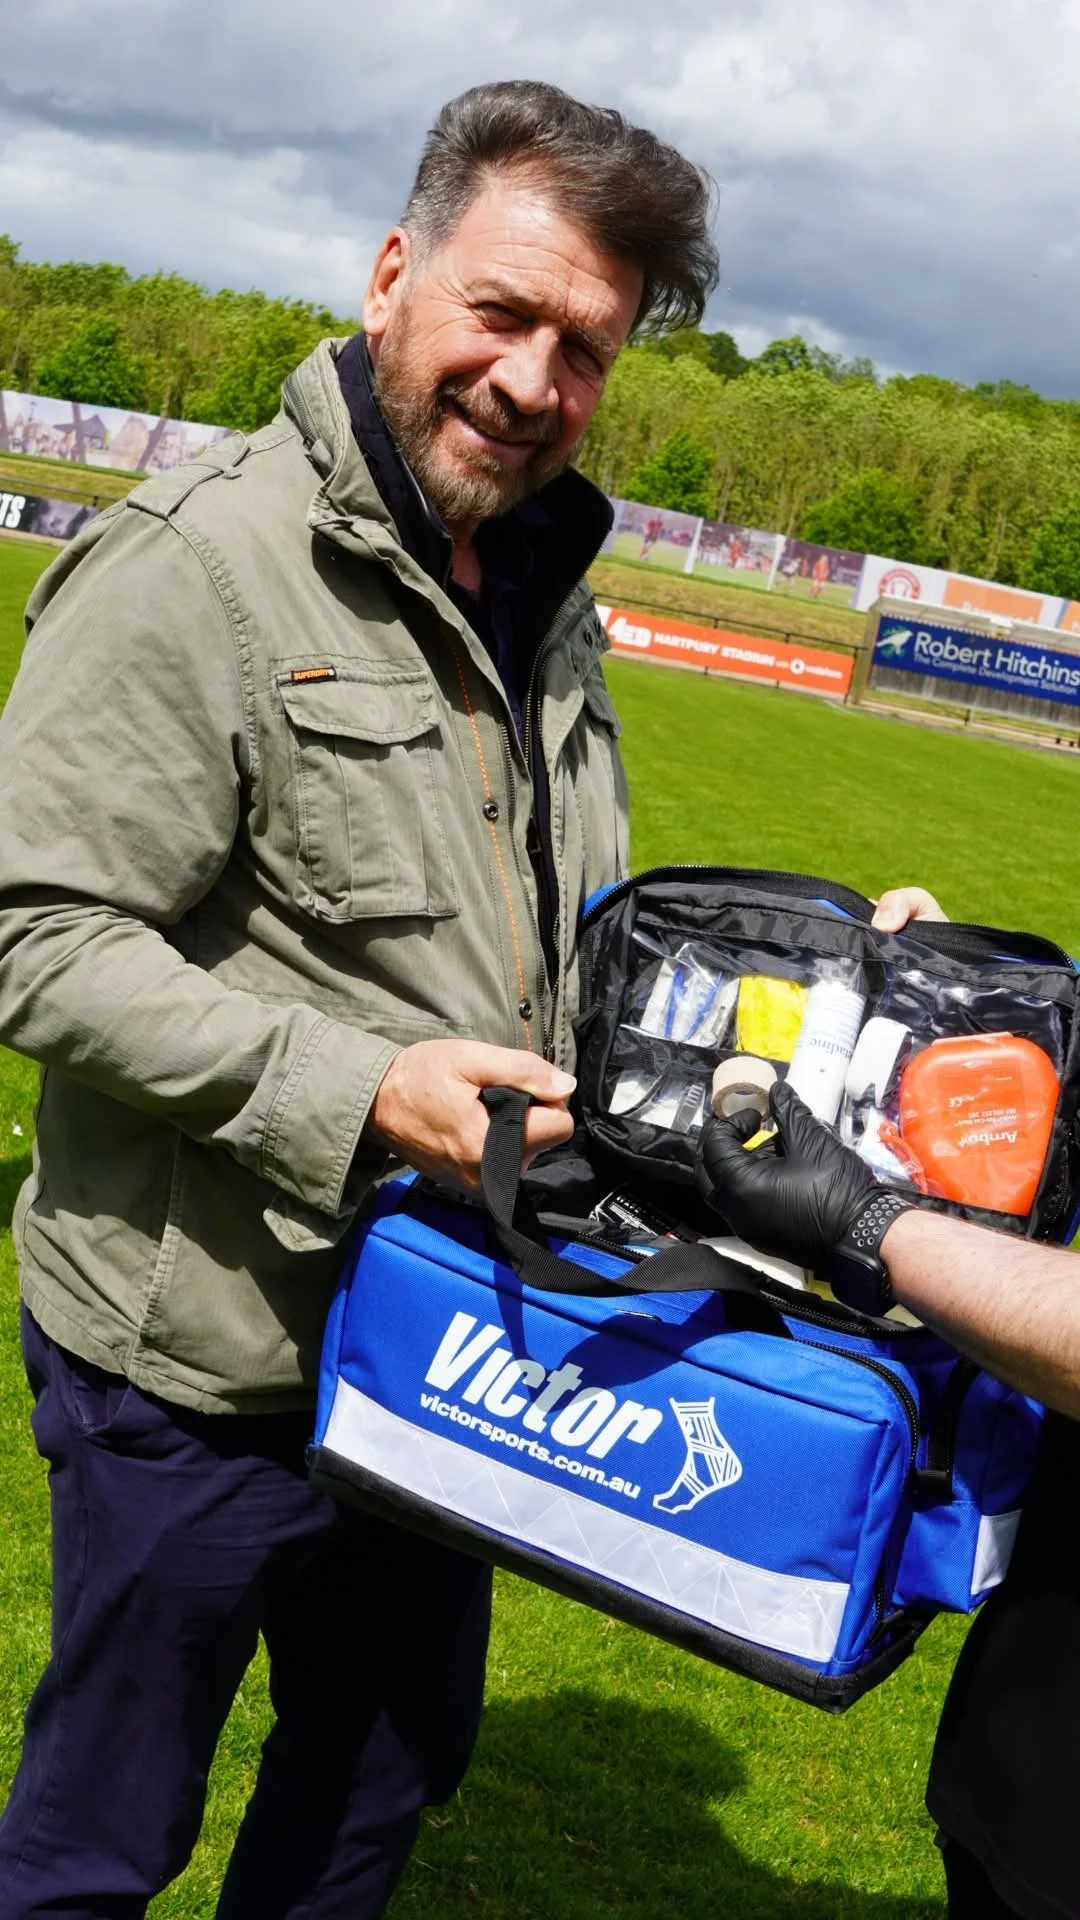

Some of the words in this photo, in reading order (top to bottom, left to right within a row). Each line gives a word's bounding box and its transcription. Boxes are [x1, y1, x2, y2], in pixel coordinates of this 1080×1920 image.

[0, 492, 26, 528] TS
[653, 632, 719, 655] HARTPURY
[721, 645, 776, 667] STADIUM
[914, 631, 992, 668] Robert
[995, 648, 1080, 686] Hitchins
[914, 653, 931, 665] The
[933, 657, 977, 676] Complete
[979, 666, 1040, 688] Development
[1041, 680, 1077, 695] Solution
[967, 1131, 1017, 1147] Ambu
[424, 1311, 663, 1459] Victor
[420, 1393, 641, 1499] victorsports.com.au
